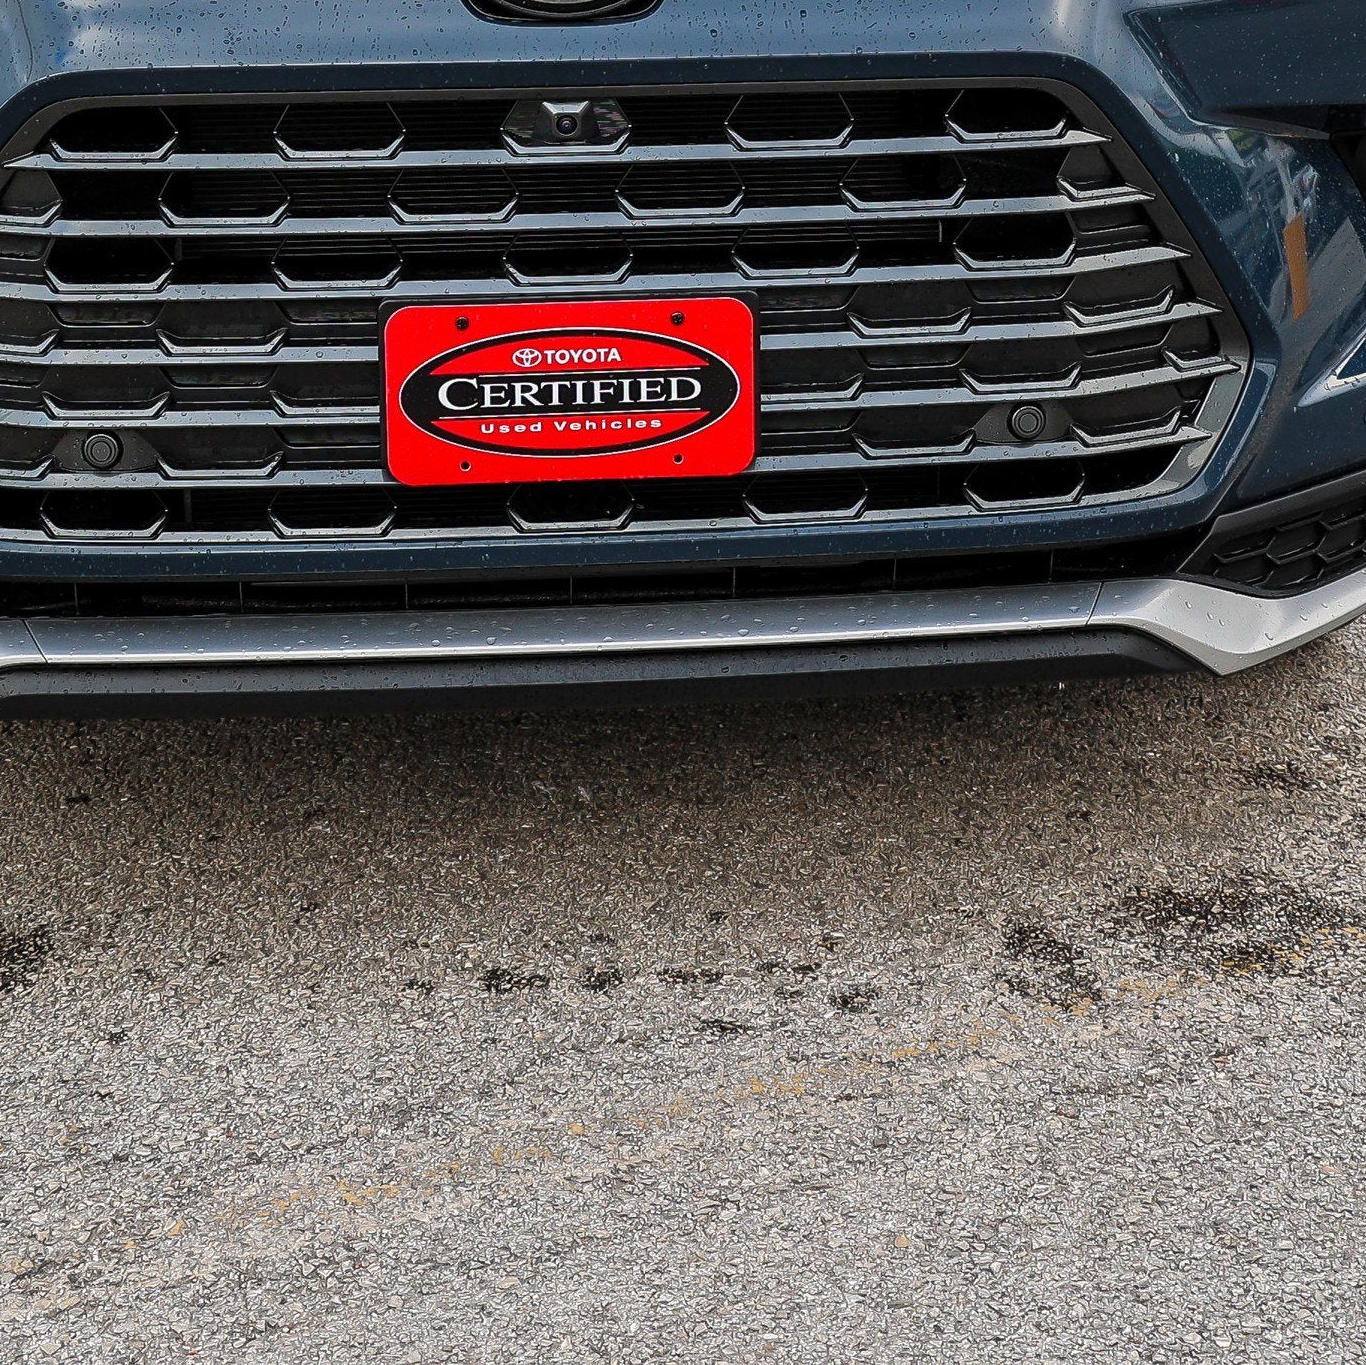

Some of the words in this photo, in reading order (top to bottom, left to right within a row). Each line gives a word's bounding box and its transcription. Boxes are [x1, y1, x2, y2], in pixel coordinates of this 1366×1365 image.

[543, 347, 622, 365] TOYOTA
[437, 376, 702, 411] CERTIFIED
[480, 421, 542, 434] Used
[553, 417, 663, 432] Vehicles
